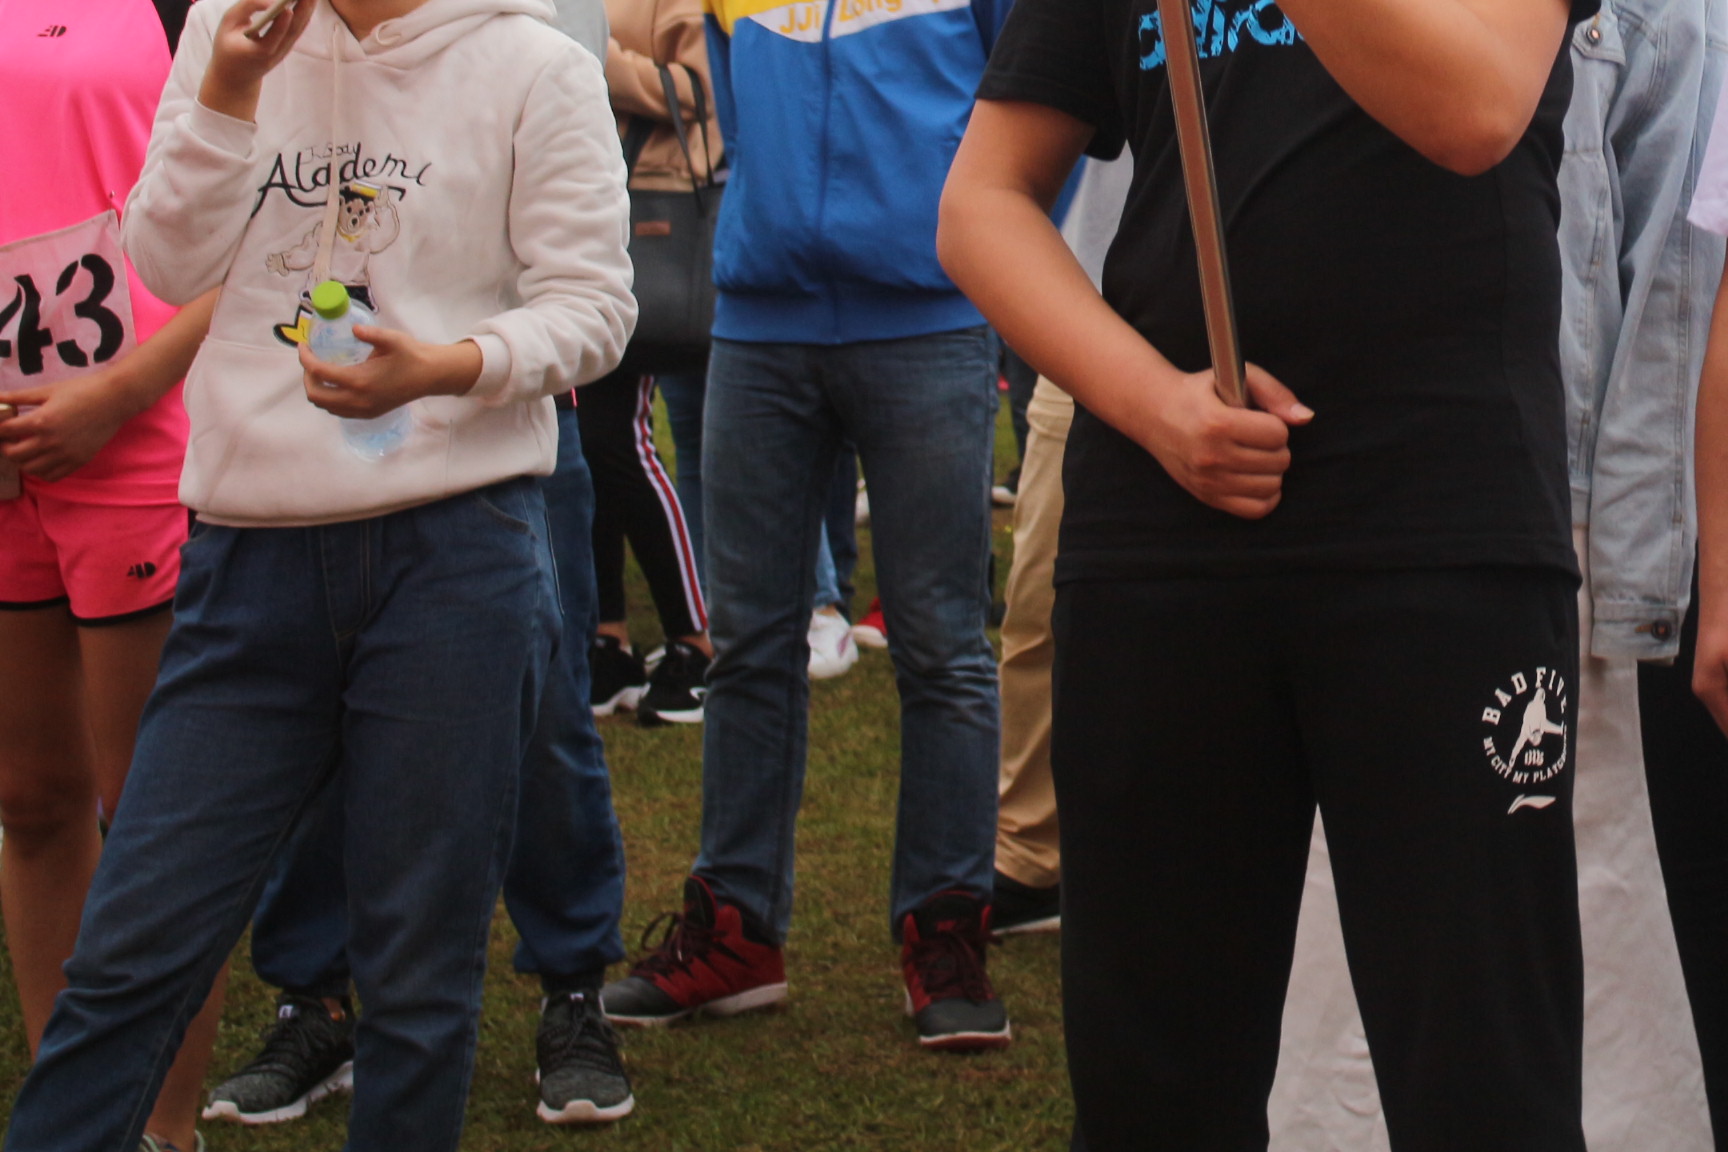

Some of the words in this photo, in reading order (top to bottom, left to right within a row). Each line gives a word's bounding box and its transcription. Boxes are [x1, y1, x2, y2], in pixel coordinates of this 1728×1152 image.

[0, 253, 124, 376] 43
[1482, 671, 1528, 726] BAD
[1512, 770, 1530, 784] MY
